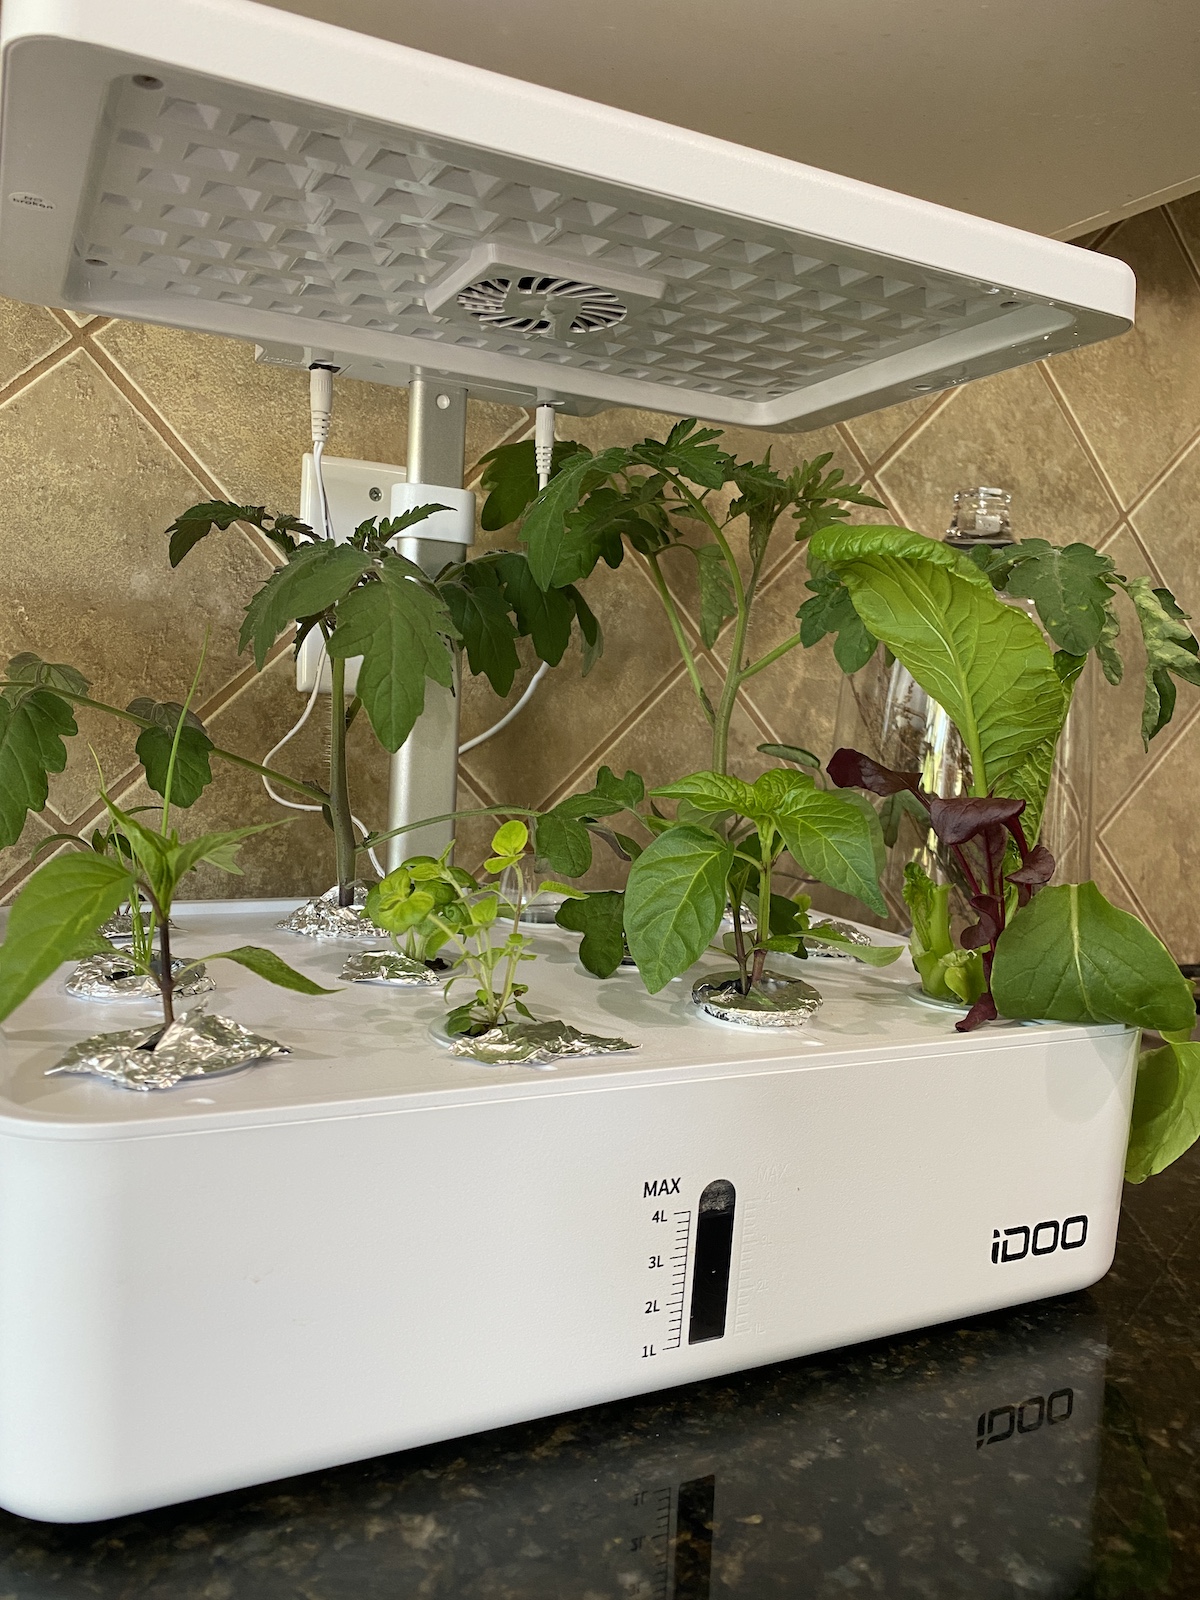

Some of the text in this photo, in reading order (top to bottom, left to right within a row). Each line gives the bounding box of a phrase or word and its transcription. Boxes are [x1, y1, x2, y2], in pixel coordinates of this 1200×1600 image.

[643, 1177, 681, 1198] MAX
[652, 1210, 668, 1223] 4L
[648, 1255, 664, 1269] 3L
[644, 1300, 661, 1314] 2L
[641, 1344, 657, 1358] 1L
